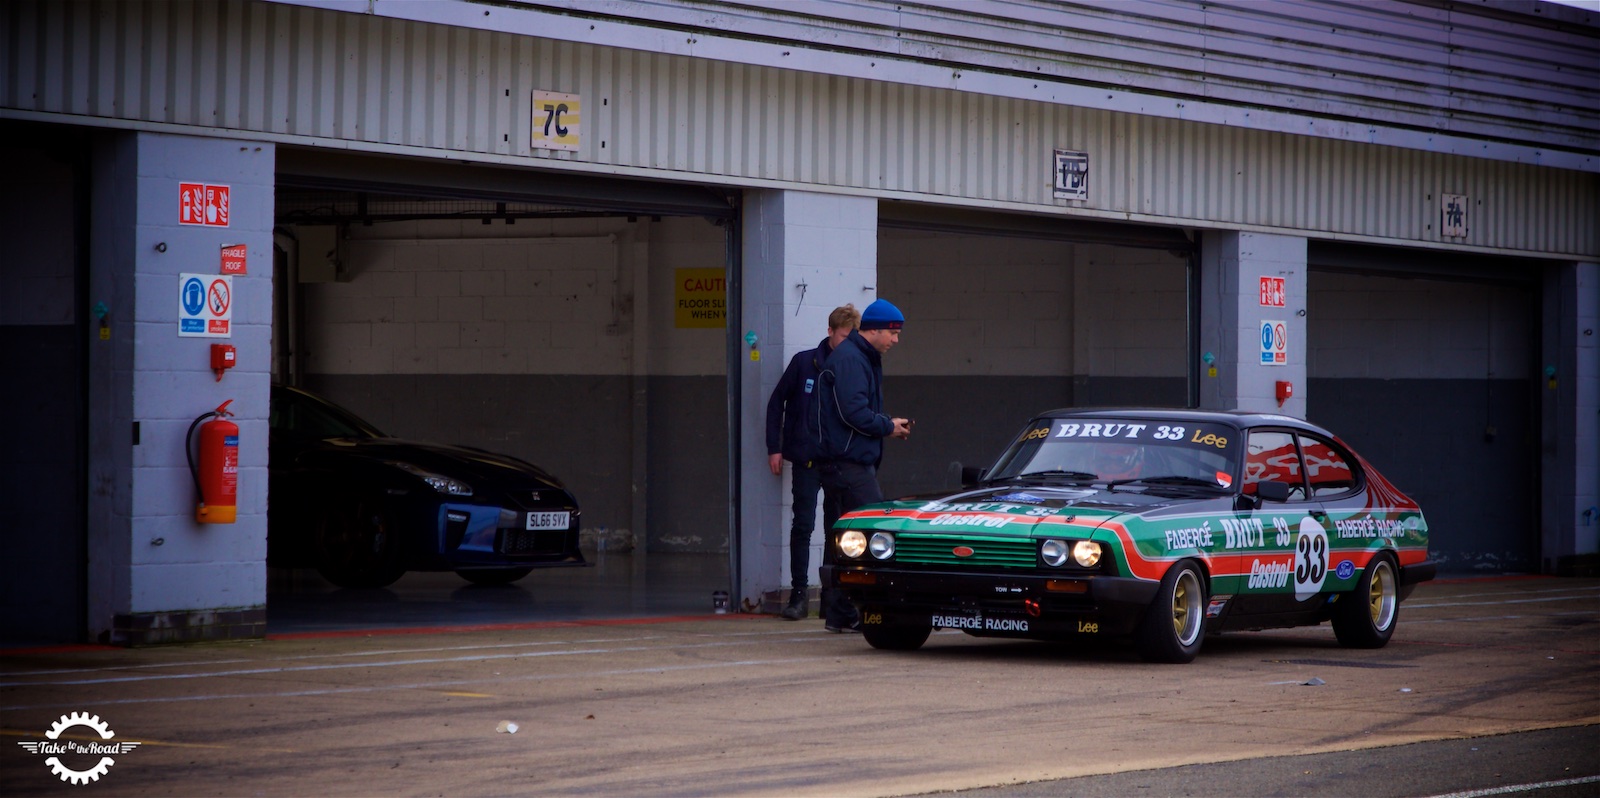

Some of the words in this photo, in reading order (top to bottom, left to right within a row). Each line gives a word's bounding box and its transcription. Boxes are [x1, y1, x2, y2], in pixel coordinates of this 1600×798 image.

[543, 103, 569, 138] 7C
[1447, 203, 1462, 228] 7A
[222, 249, 244, 258] FRAGILE
[679, 299, 710, 308] FLOOR
[691, 310, 720, 319] WHEN
[1019, 427, 1050, 442] Lee
[1055, 423, 1147, 439] BRUT
[1153, 425, 1186, 441] 33
[1191, 429, 1228, 449] Lee
[530, 514, 550, 527] SL66
[552, 514, 567, 526] SVX
[929, 513, 1016, 529] Castrol
[1334, 514, 1376, 539] FABERGÉ
[1377, 519, 1405, 538] RACING
[1164, 520, 1214, 550] FABERGÉ
[1219, 518, 1265, 549] BRUT
[1272, 517, 1290, 547] 33
[1296, 534, 1325, 584] 33
[1248, 558, 1292, 589] Castrol
[1339, 563, 1352, 576] Ford
[863, 611, 882, 625] Lee
[931, 611, 982, 630] FABERGÉ
[985, 619, 1029, 632] RACING
[1078, 620, 1099, 633] Lee
